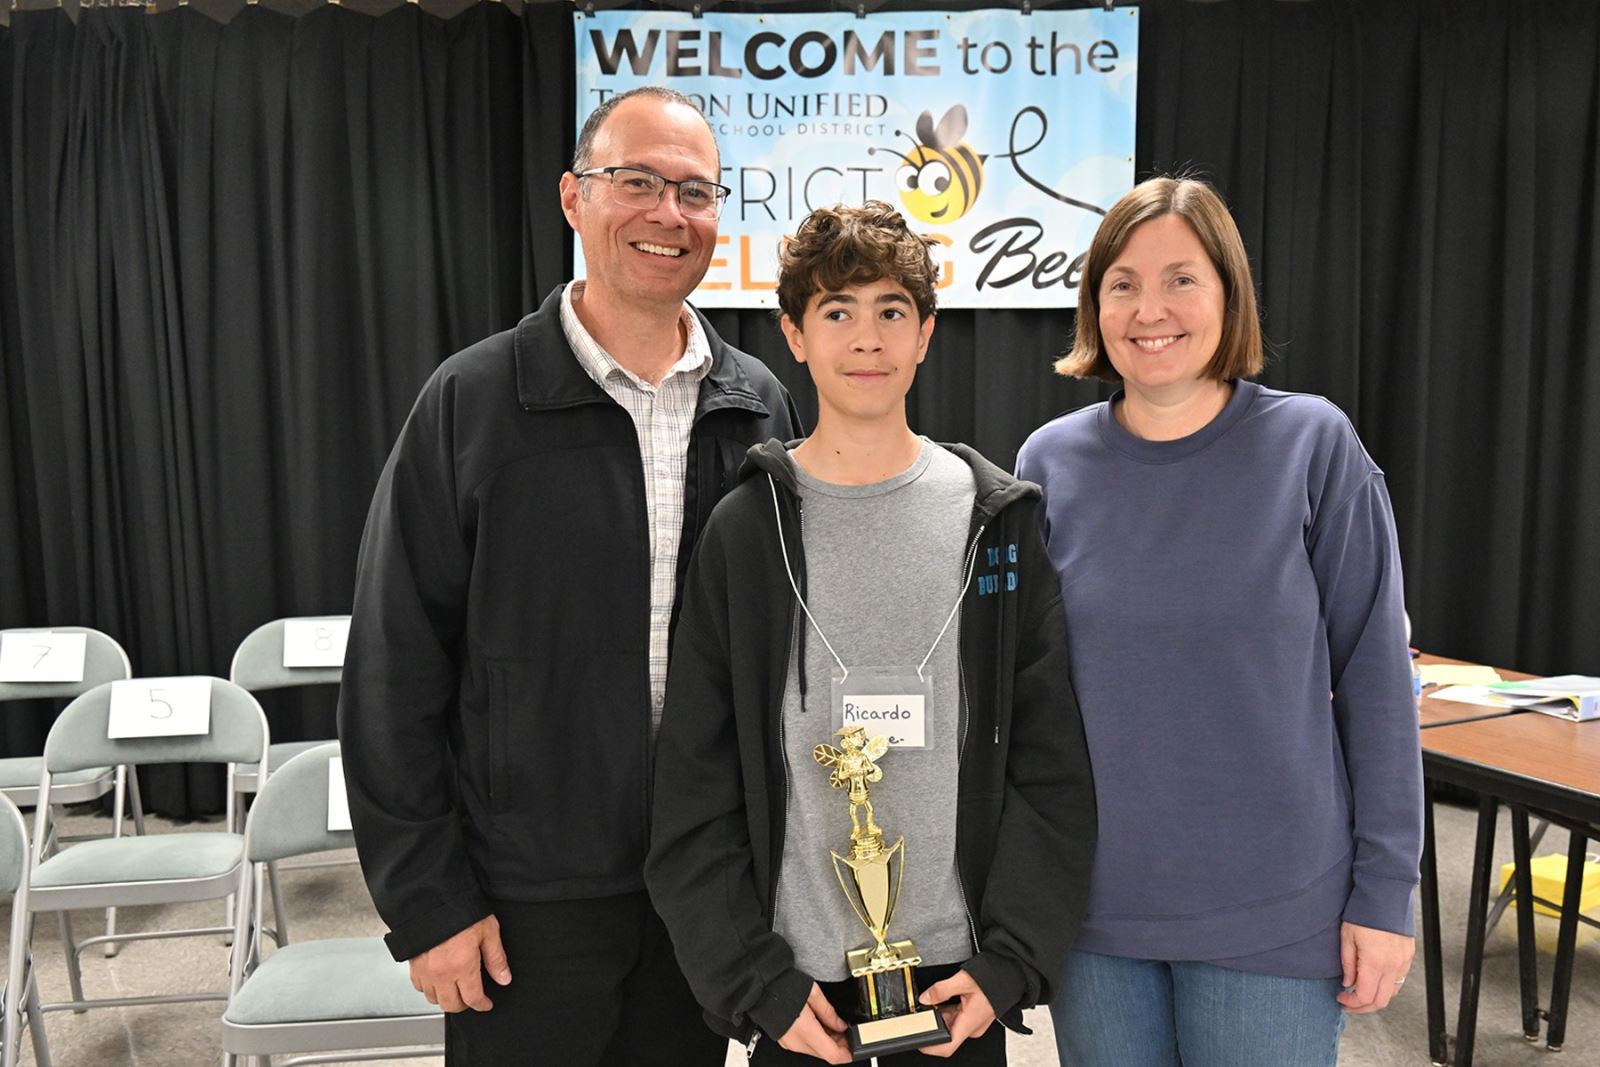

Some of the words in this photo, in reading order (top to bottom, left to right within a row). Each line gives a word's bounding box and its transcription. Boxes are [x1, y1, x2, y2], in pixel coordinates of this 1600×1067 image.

[589, 28, 941, 81] WELCOME
[957, 36, 1013, 76] to
[1030, 31, 1120, 77] the
[746, 92, 888, 120] UNIFIED
[798, 122, 887, 136] DISTRICT
[314, 627, 333, 651] 8
[32, 644, 52, 668] 7
[149, 687, 174, 720] 5
[844, 702, 912, 722] Ricardo
